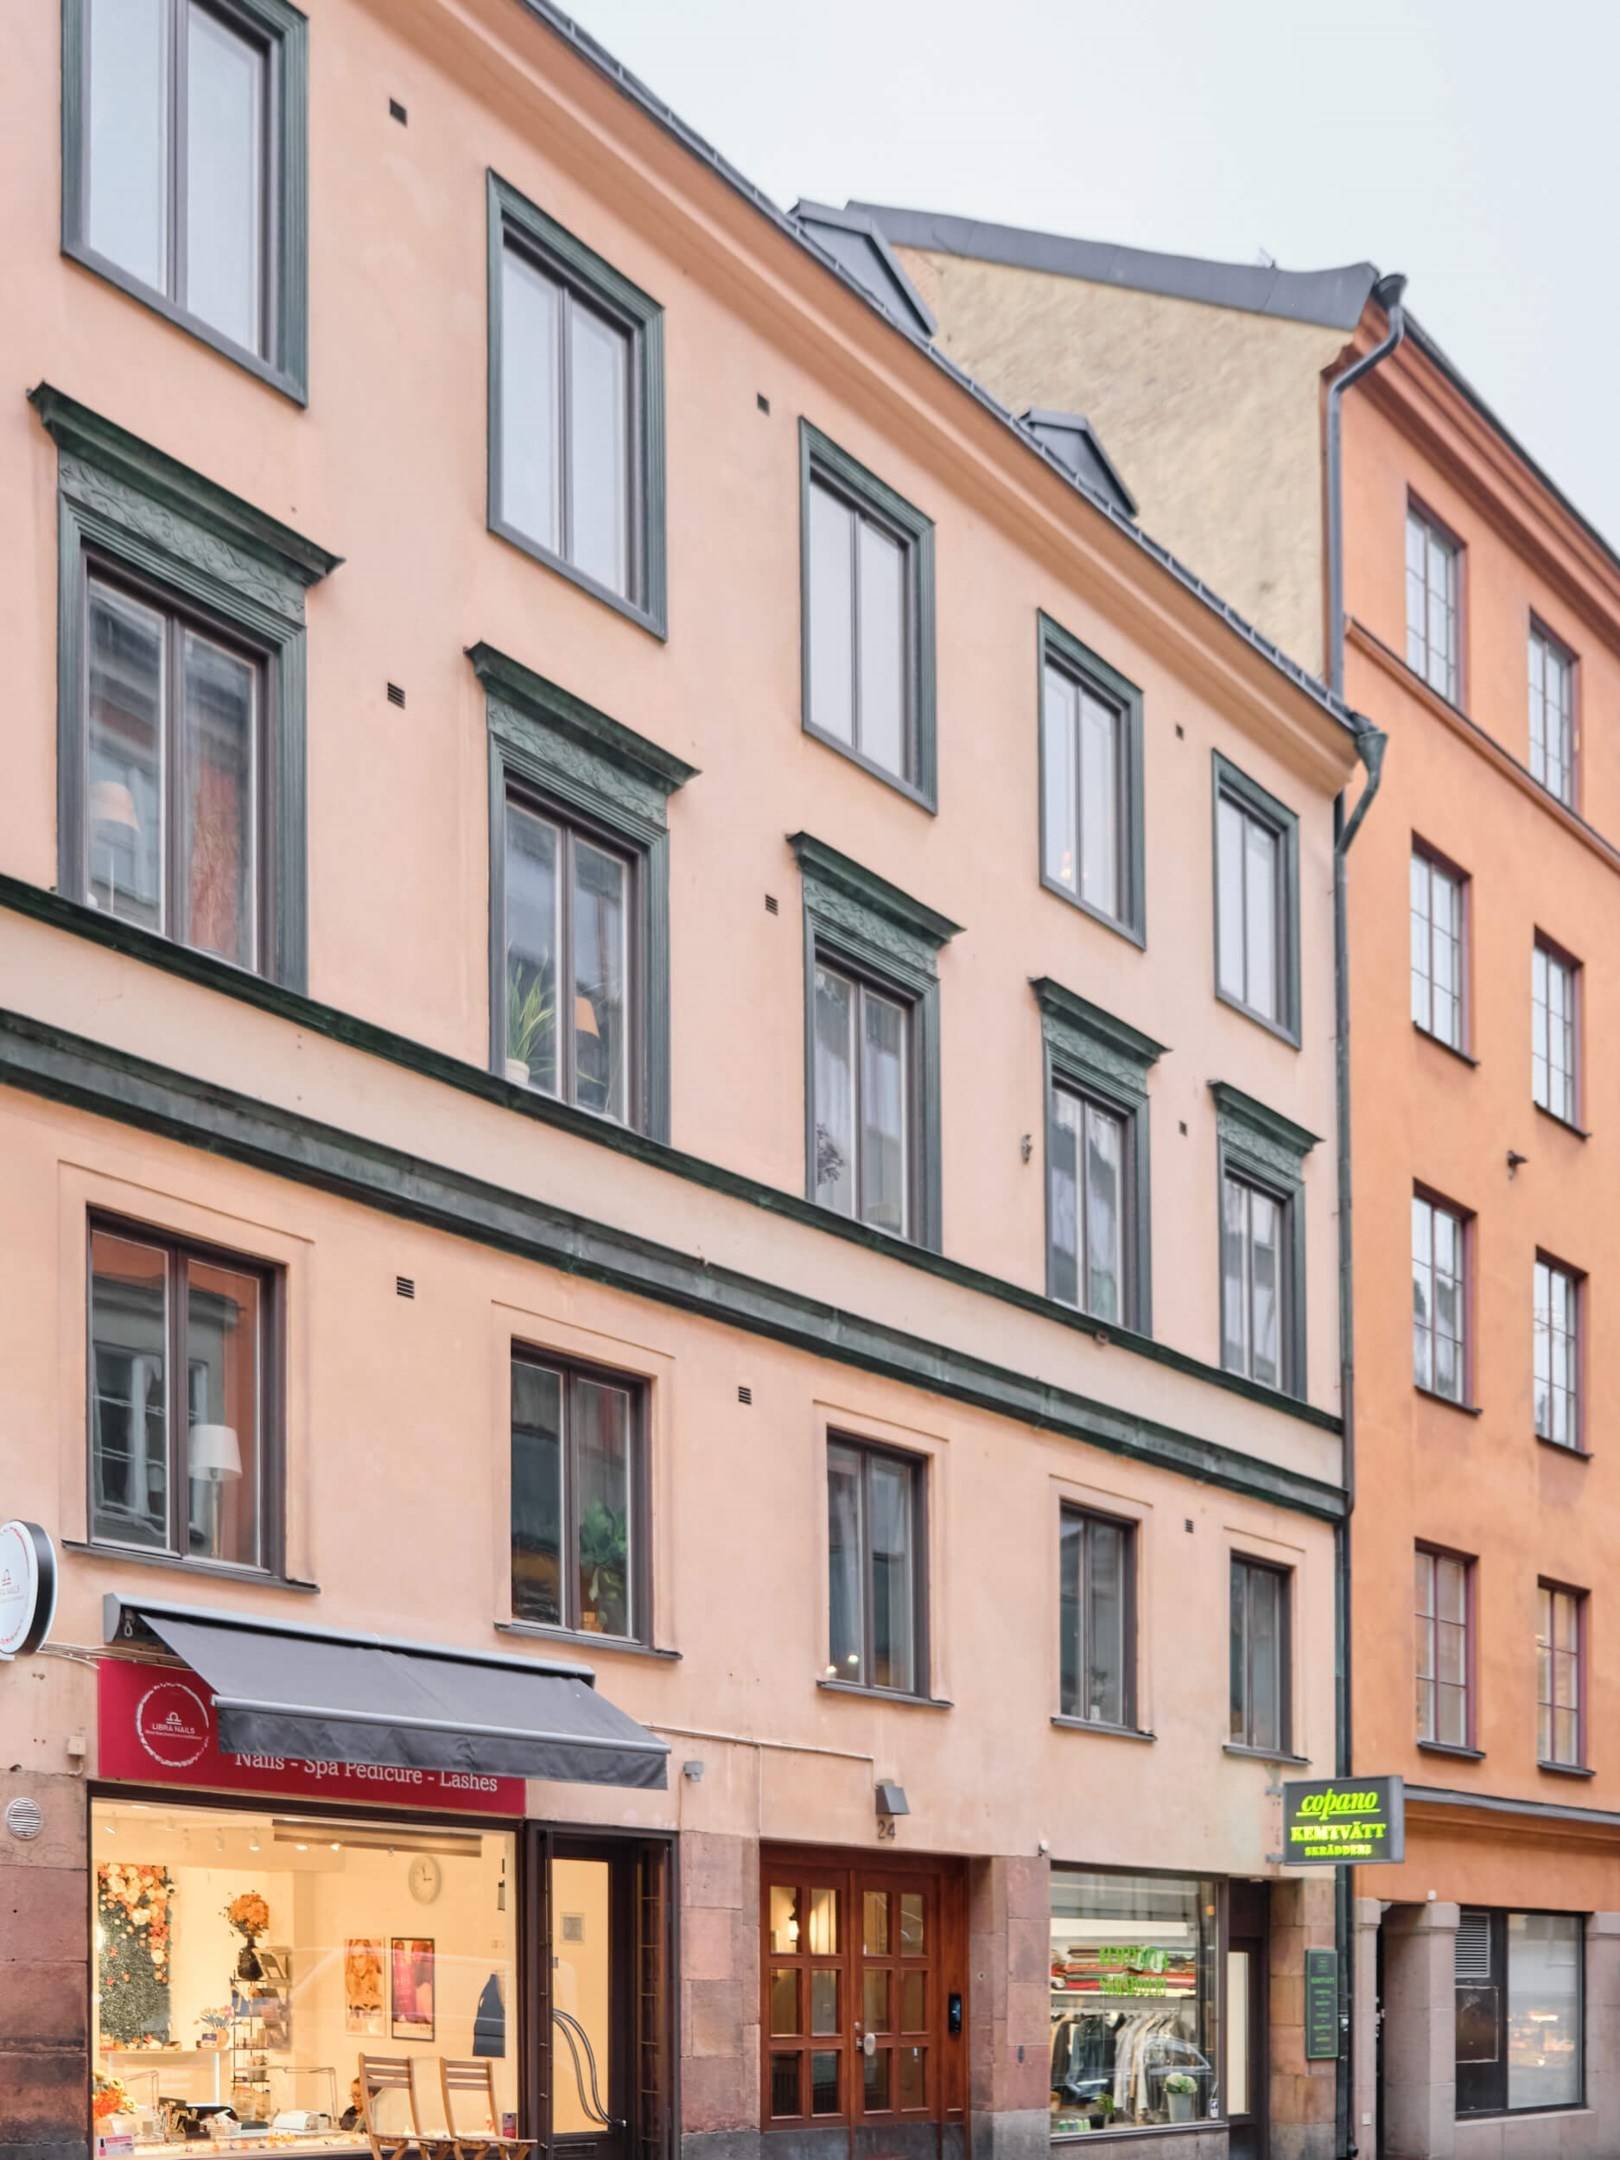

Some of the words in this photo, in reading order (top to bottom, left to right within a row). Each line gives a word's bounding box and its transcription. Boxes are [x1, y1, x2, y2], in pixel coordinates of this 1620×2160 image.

[152, 1723, 173, 1733] LIBRA
[174, 1726, 195, 1735] NAILS
[235, 1752, 285, 1770] Nails
[304, 1759, 340, 1779] Spa
[344, 1762, 423, 1784] Pedicure
[440, 1770, 498, 1792] Lashes
[1301, 1788, 1378, 1820] copano
[877, 1820, 896, 1840] 24
[1291, 1821, 1386, 1841] KEMTVÄTT
